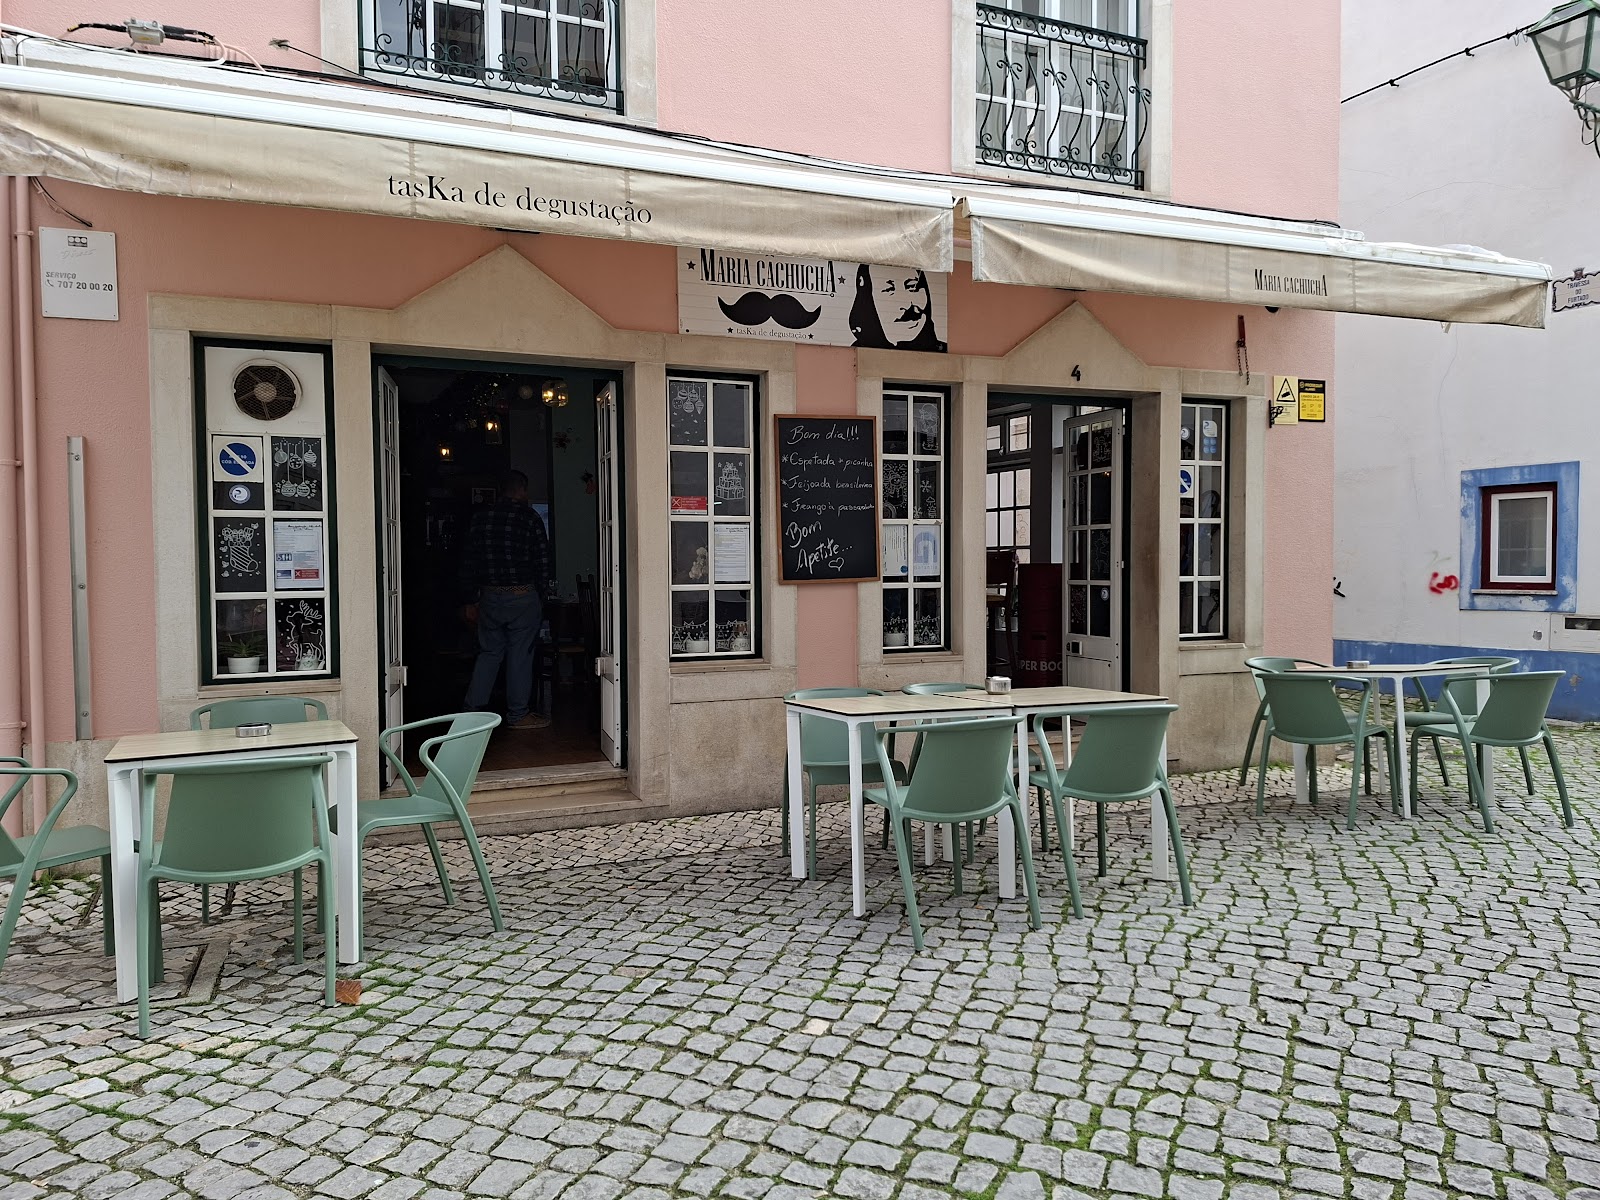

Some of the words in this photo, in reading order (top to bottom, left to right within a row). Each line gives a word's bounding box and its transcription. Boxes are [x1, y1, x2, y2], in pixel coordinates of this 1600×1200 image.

[388, 175, 467, 203] tasKa
[474, 182, 507, 208] de
[516, 187, 653, 226] degustação
[45, 271, 77, 280] SERVIÇO
[700, 248, 752, 286] MARIA
[756, 259, 838, 293] CACHUCHA
[76, 281, 87, 290] 20
[89, 282, 100, 291] 00
[102, 283, 113, 292] 20
[1254, 268, 1282, 292] MARIA
[1283, 274, 1328, 297] CACHUCHA
[736, 327, 757, 336] tasKa
[758, 328, 767, 337] de
[769, 329, 807, 340] degustação
[1070, 364, 1082, 382] 4
[785, 521, 822, 549] Bom
[1019, 660, 1038, 671] PER
